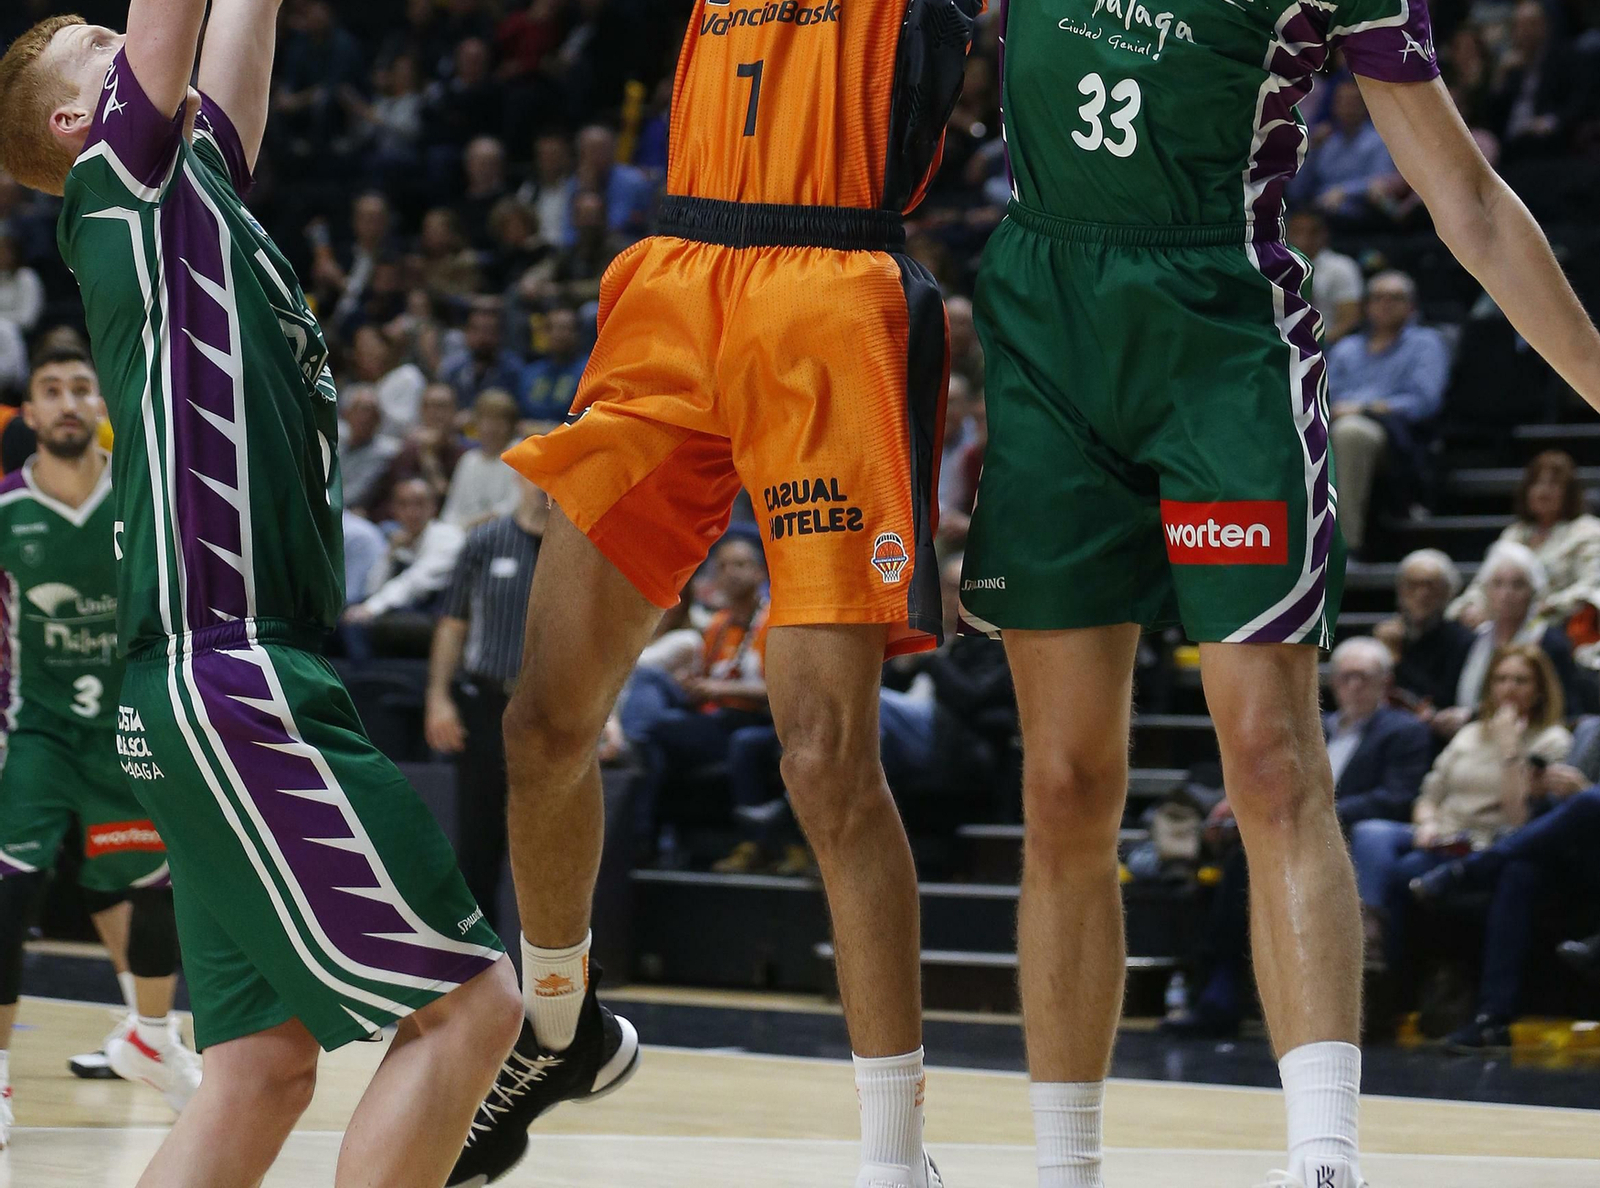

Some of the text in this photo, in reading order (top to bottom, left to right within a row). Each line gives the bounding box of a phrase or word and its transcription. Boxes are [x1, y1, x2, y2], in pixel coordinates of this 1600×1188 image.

[1058, 17, 1102, 40] Ciudad
[736, 59, 764, 137] 1
[1071, 72, 1142, 158] 33
[764, 478, 847, 512] CASUAL
[1165, 518, 1271, 548] worten
[69, 674, 103, 719] 3
